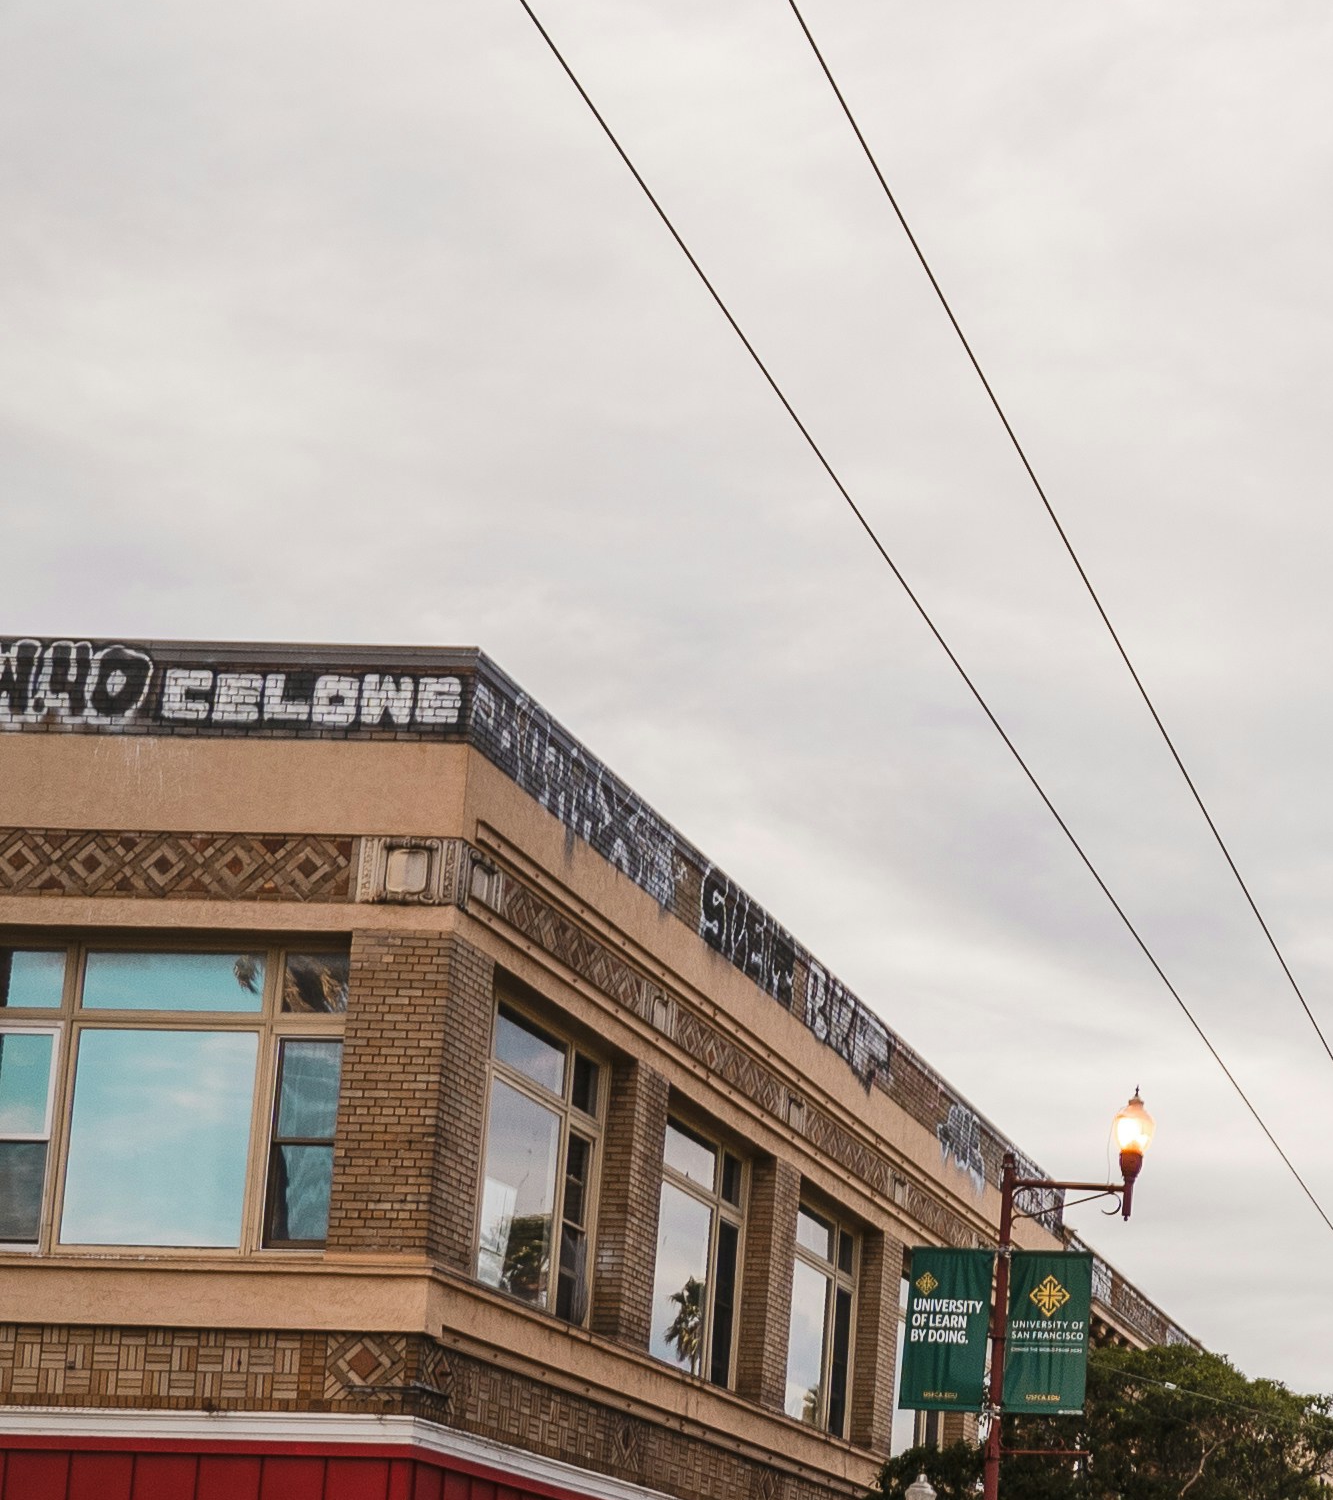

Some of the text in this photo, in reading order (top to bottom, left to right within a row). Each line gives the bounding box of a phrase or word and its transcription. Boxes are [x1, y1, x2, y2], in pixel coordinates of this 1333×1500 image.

[913, 1298, 983, 1314] UNIVERSITY
[911, 1313, 967, 1329] OF LEARN
[1012, 1320, 1085, 1330] UNIVERSITY OF
[910, 1329, 969, 1345] BY DOING.
[1011, 1330, 1084, 1341] SAN FRANCISCO
